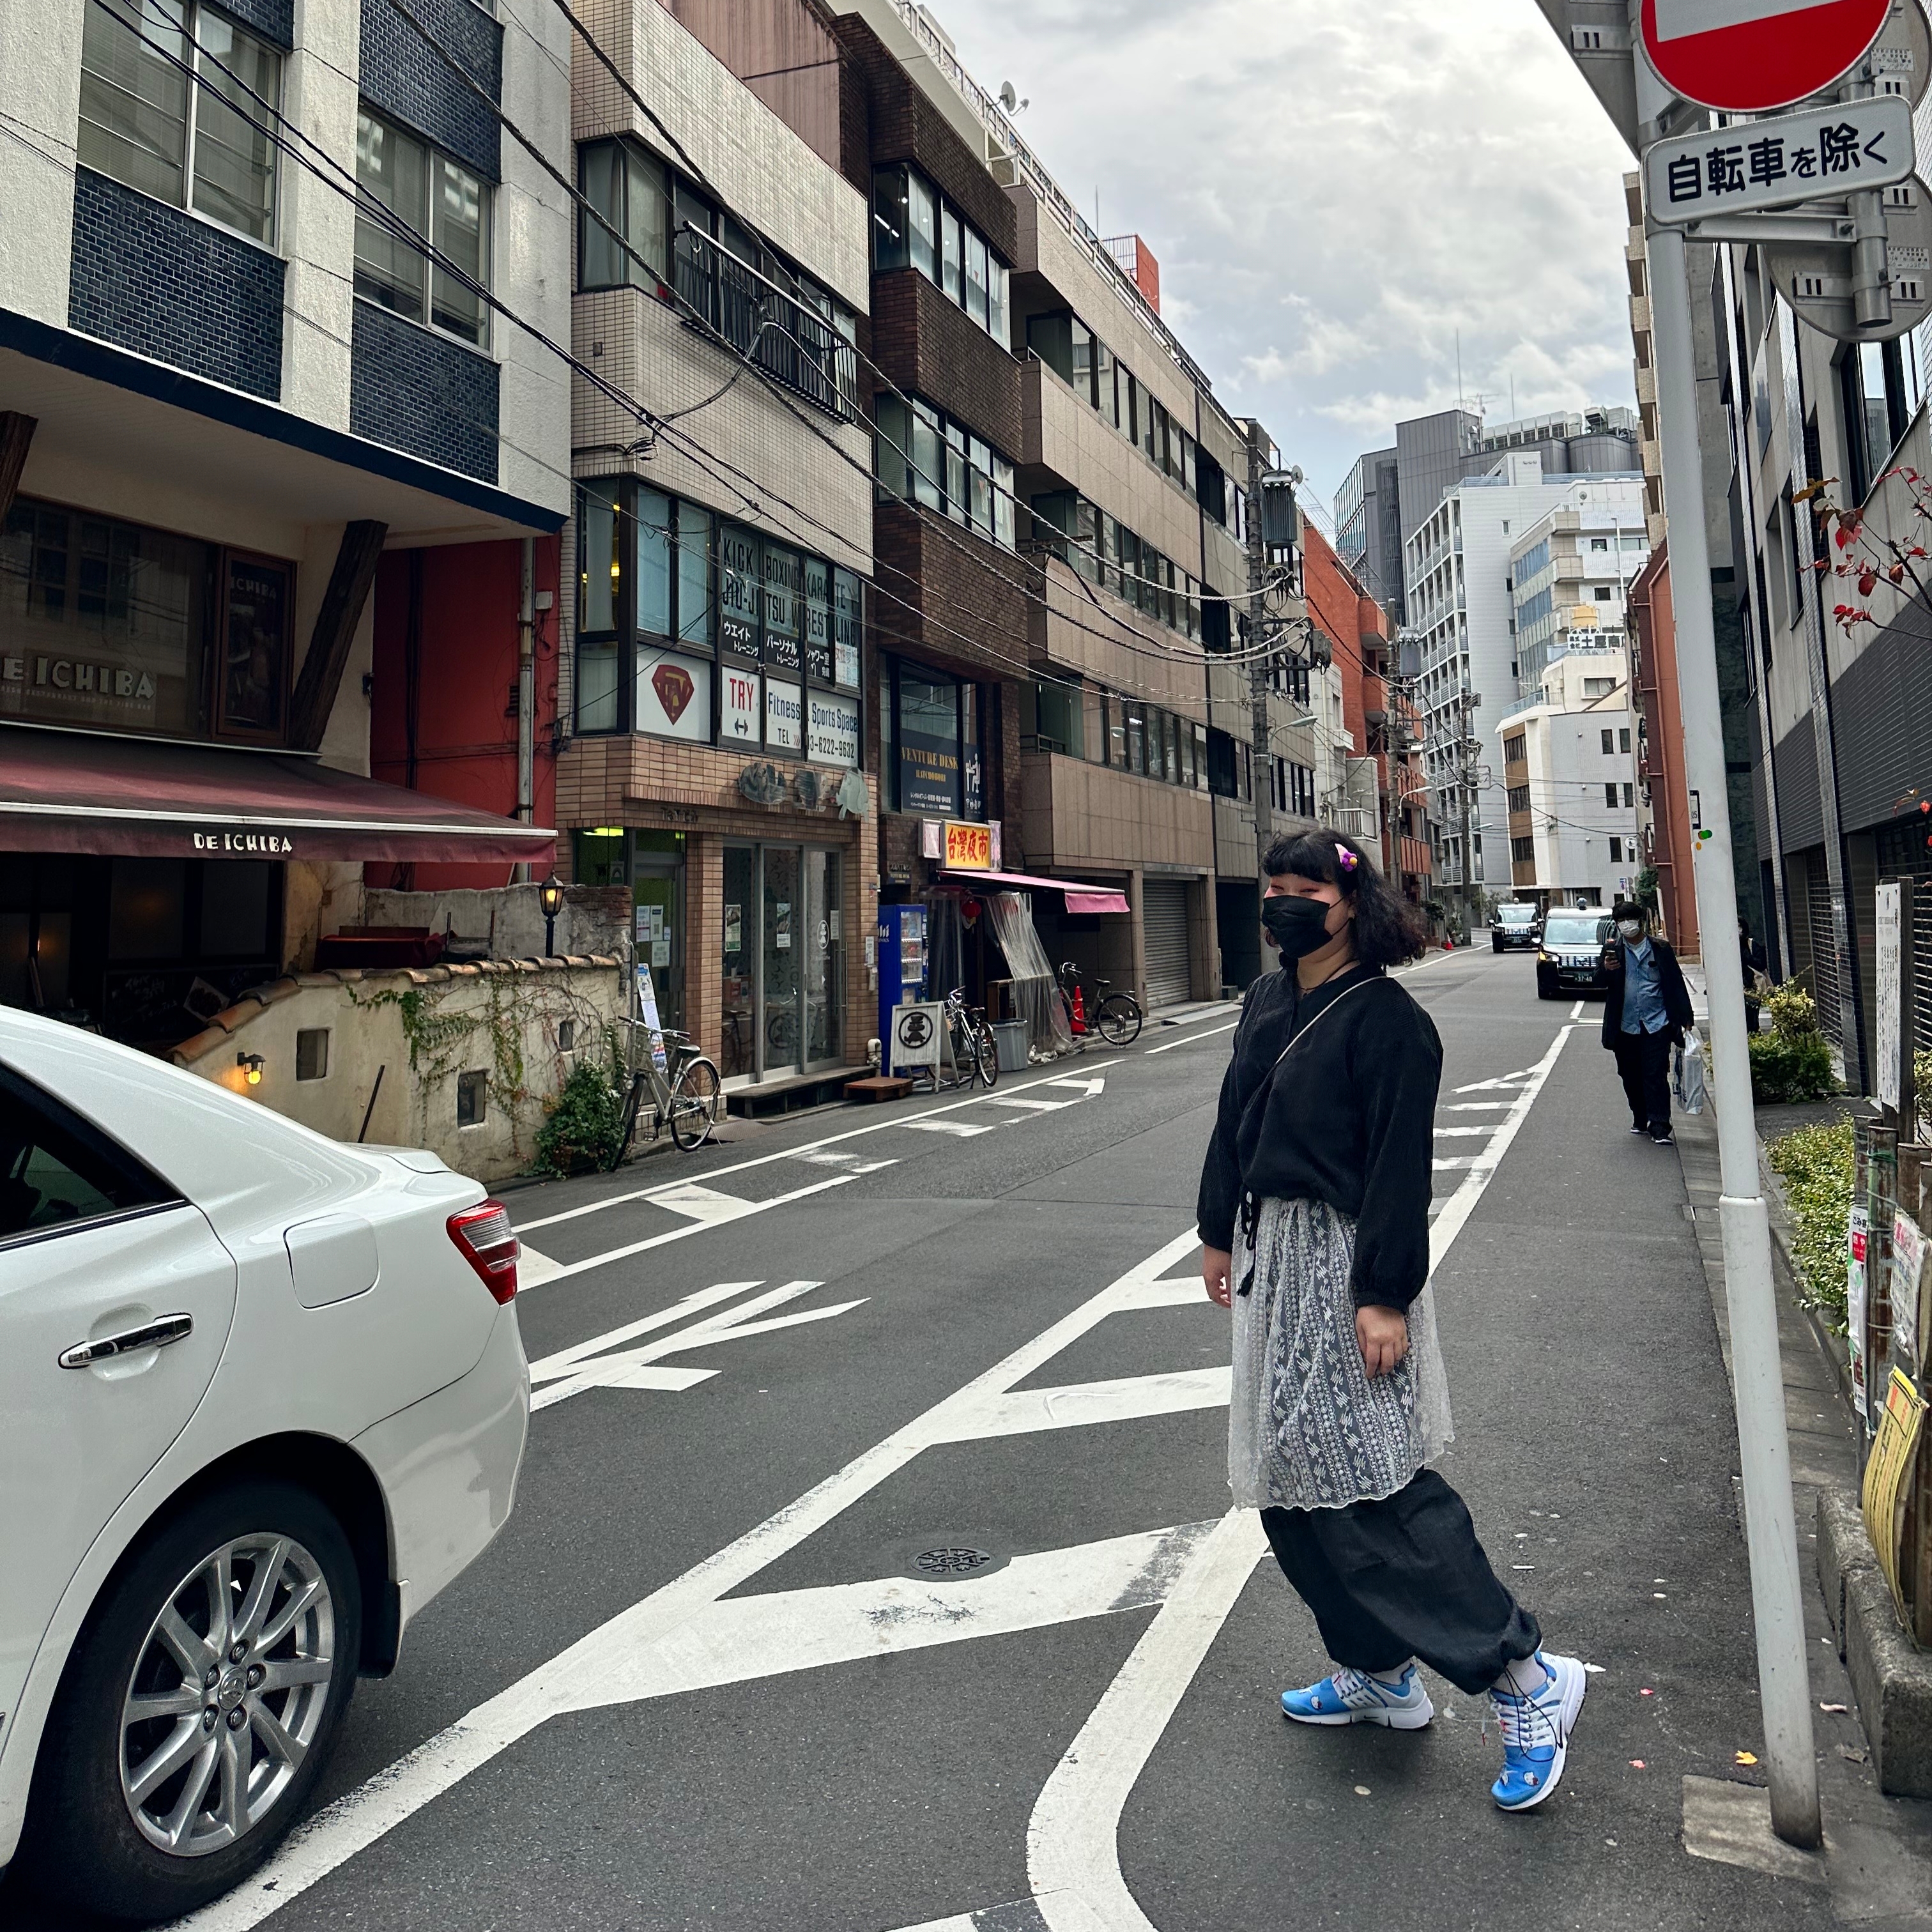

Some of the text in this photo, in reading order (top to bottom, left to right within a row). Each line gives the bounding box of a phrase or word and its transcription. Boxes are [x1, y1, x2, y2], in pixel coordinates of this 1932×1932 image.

[1668, 122, 1887, 203] 自転車を除く
[723, 537, 753, 574] KICK
[766, 555, 799, 591] BOXING
[724, 621, 751, 641] ウエイト
[733, 641, 758, 657] トレーニング
[767, 634, 797, 655] パーソナル
[776, 653, 799, 668] トレーニング
[3, 657, 155, 699] E ICHIBA
[730, 678, 754, 712] TRY
[768, 692, 858, 735] Fitness Sports Space
[778, 728, 790, 744] TEL
[901, 746, 958, 770] VENTURE DESK
[194, 832, 293, 853] DE ICHIBA
[947, 827, 988, 862] 台灣夜市
